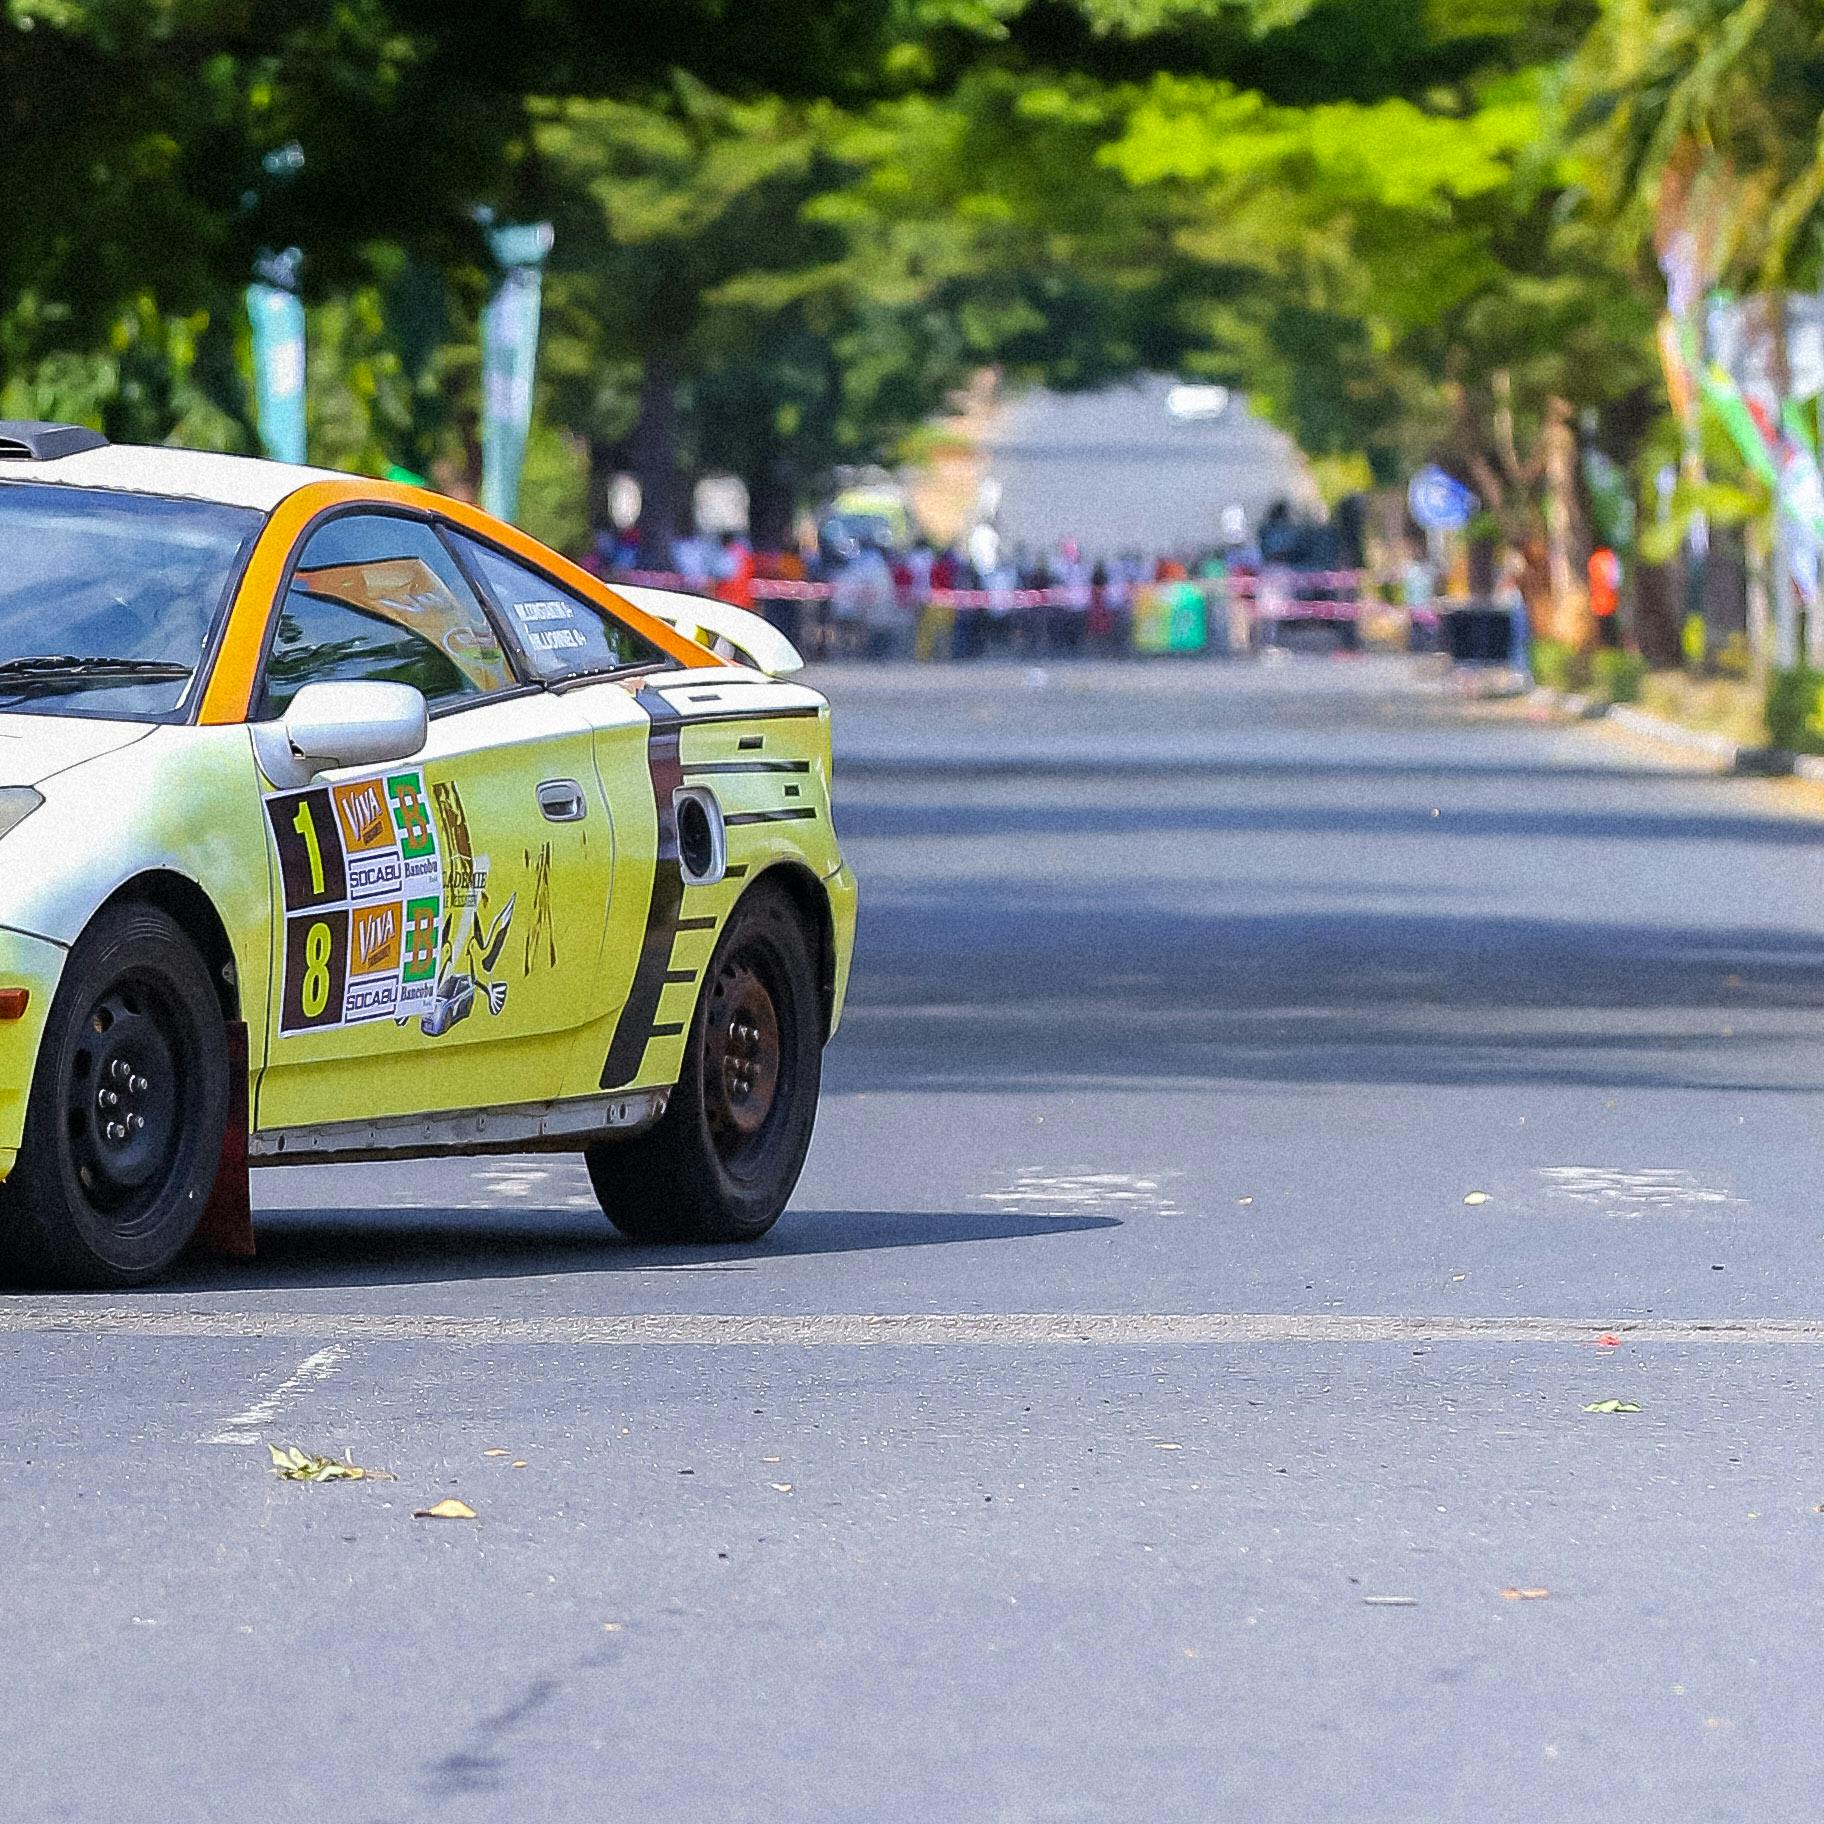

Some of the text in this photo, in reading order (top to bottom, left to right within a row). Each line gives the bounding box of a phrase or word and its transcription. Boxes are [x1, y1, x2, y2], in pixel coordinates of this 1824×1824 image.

[396, 784, 428, 849] B
[293, 801, 325, 895] 1
[403, 857, 438, 879] Bancobu
[350, 864, 401, 888] SOCABU
[409, 907, 434, 974] B
[302, 922, 332, 1018] 8
[401, 983, 434, 1001] Bancobu
[345, 987, 398, 1011] SOCABU
